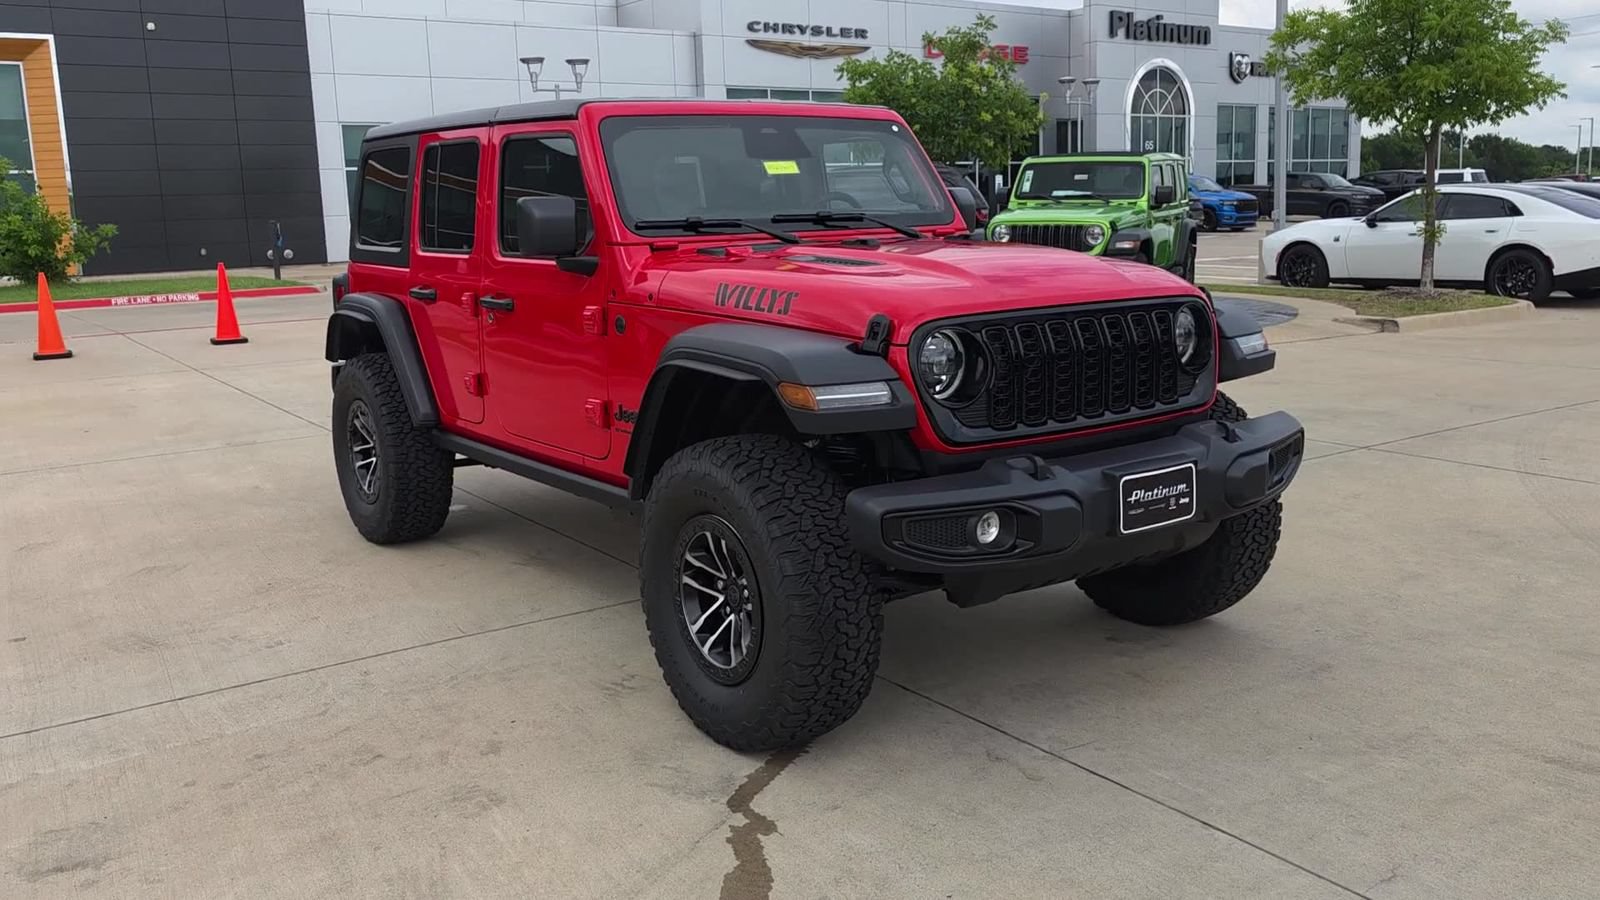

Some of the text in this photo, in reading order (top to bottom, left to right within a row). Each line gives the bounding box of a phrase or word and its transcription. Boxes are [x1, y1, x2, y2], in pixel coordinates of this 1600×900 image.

[746, 20, 869, 39] CHRYSLER
[1109, 10, 1211, 45] Platinum
[1144, 140, 1154, 150] 65
[111, 293, 200, 306] FIRE LANE NO PARKING
[715, 282, 799, 315] WILLYS
[614, 404, 638, 424] Jee
[1127, 483, 1190, 504] Platinum
